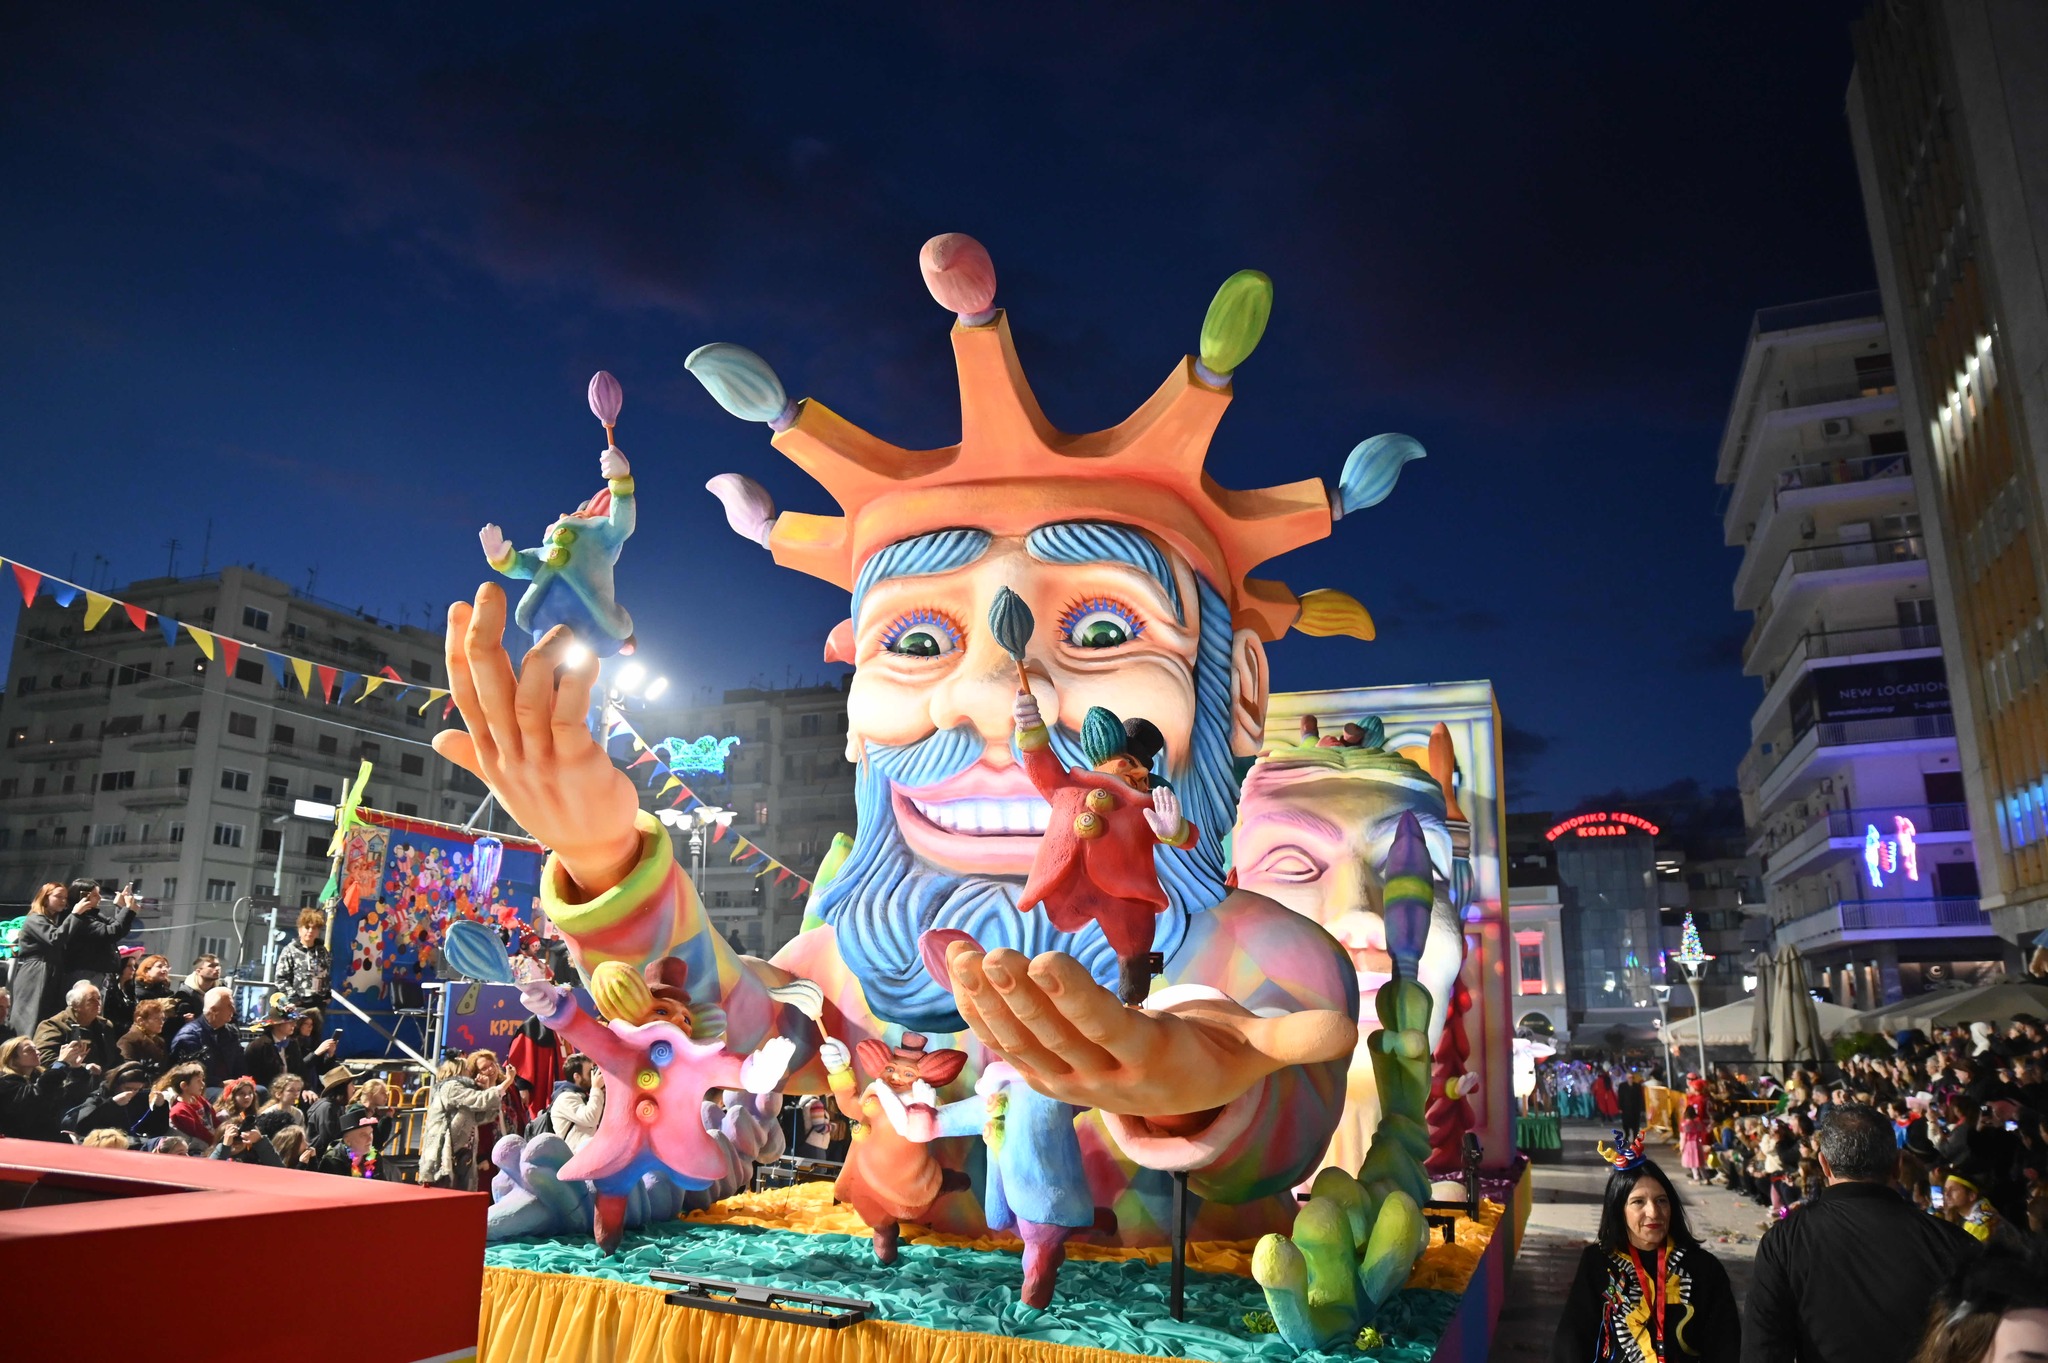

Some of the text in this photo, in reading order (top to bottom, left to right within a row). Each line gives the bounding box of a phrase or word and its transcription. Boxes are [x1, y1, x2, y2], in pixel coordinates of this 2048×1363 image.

[1839, 681, 1949, 699] NEW LOCATION
[1545, 812, 1660, 841] ΕΜΠΟΡΙΚΟ ΚΕΝΤΡΟ
[1576, 825, 1627, 837] ΚΟΛΛΑ
